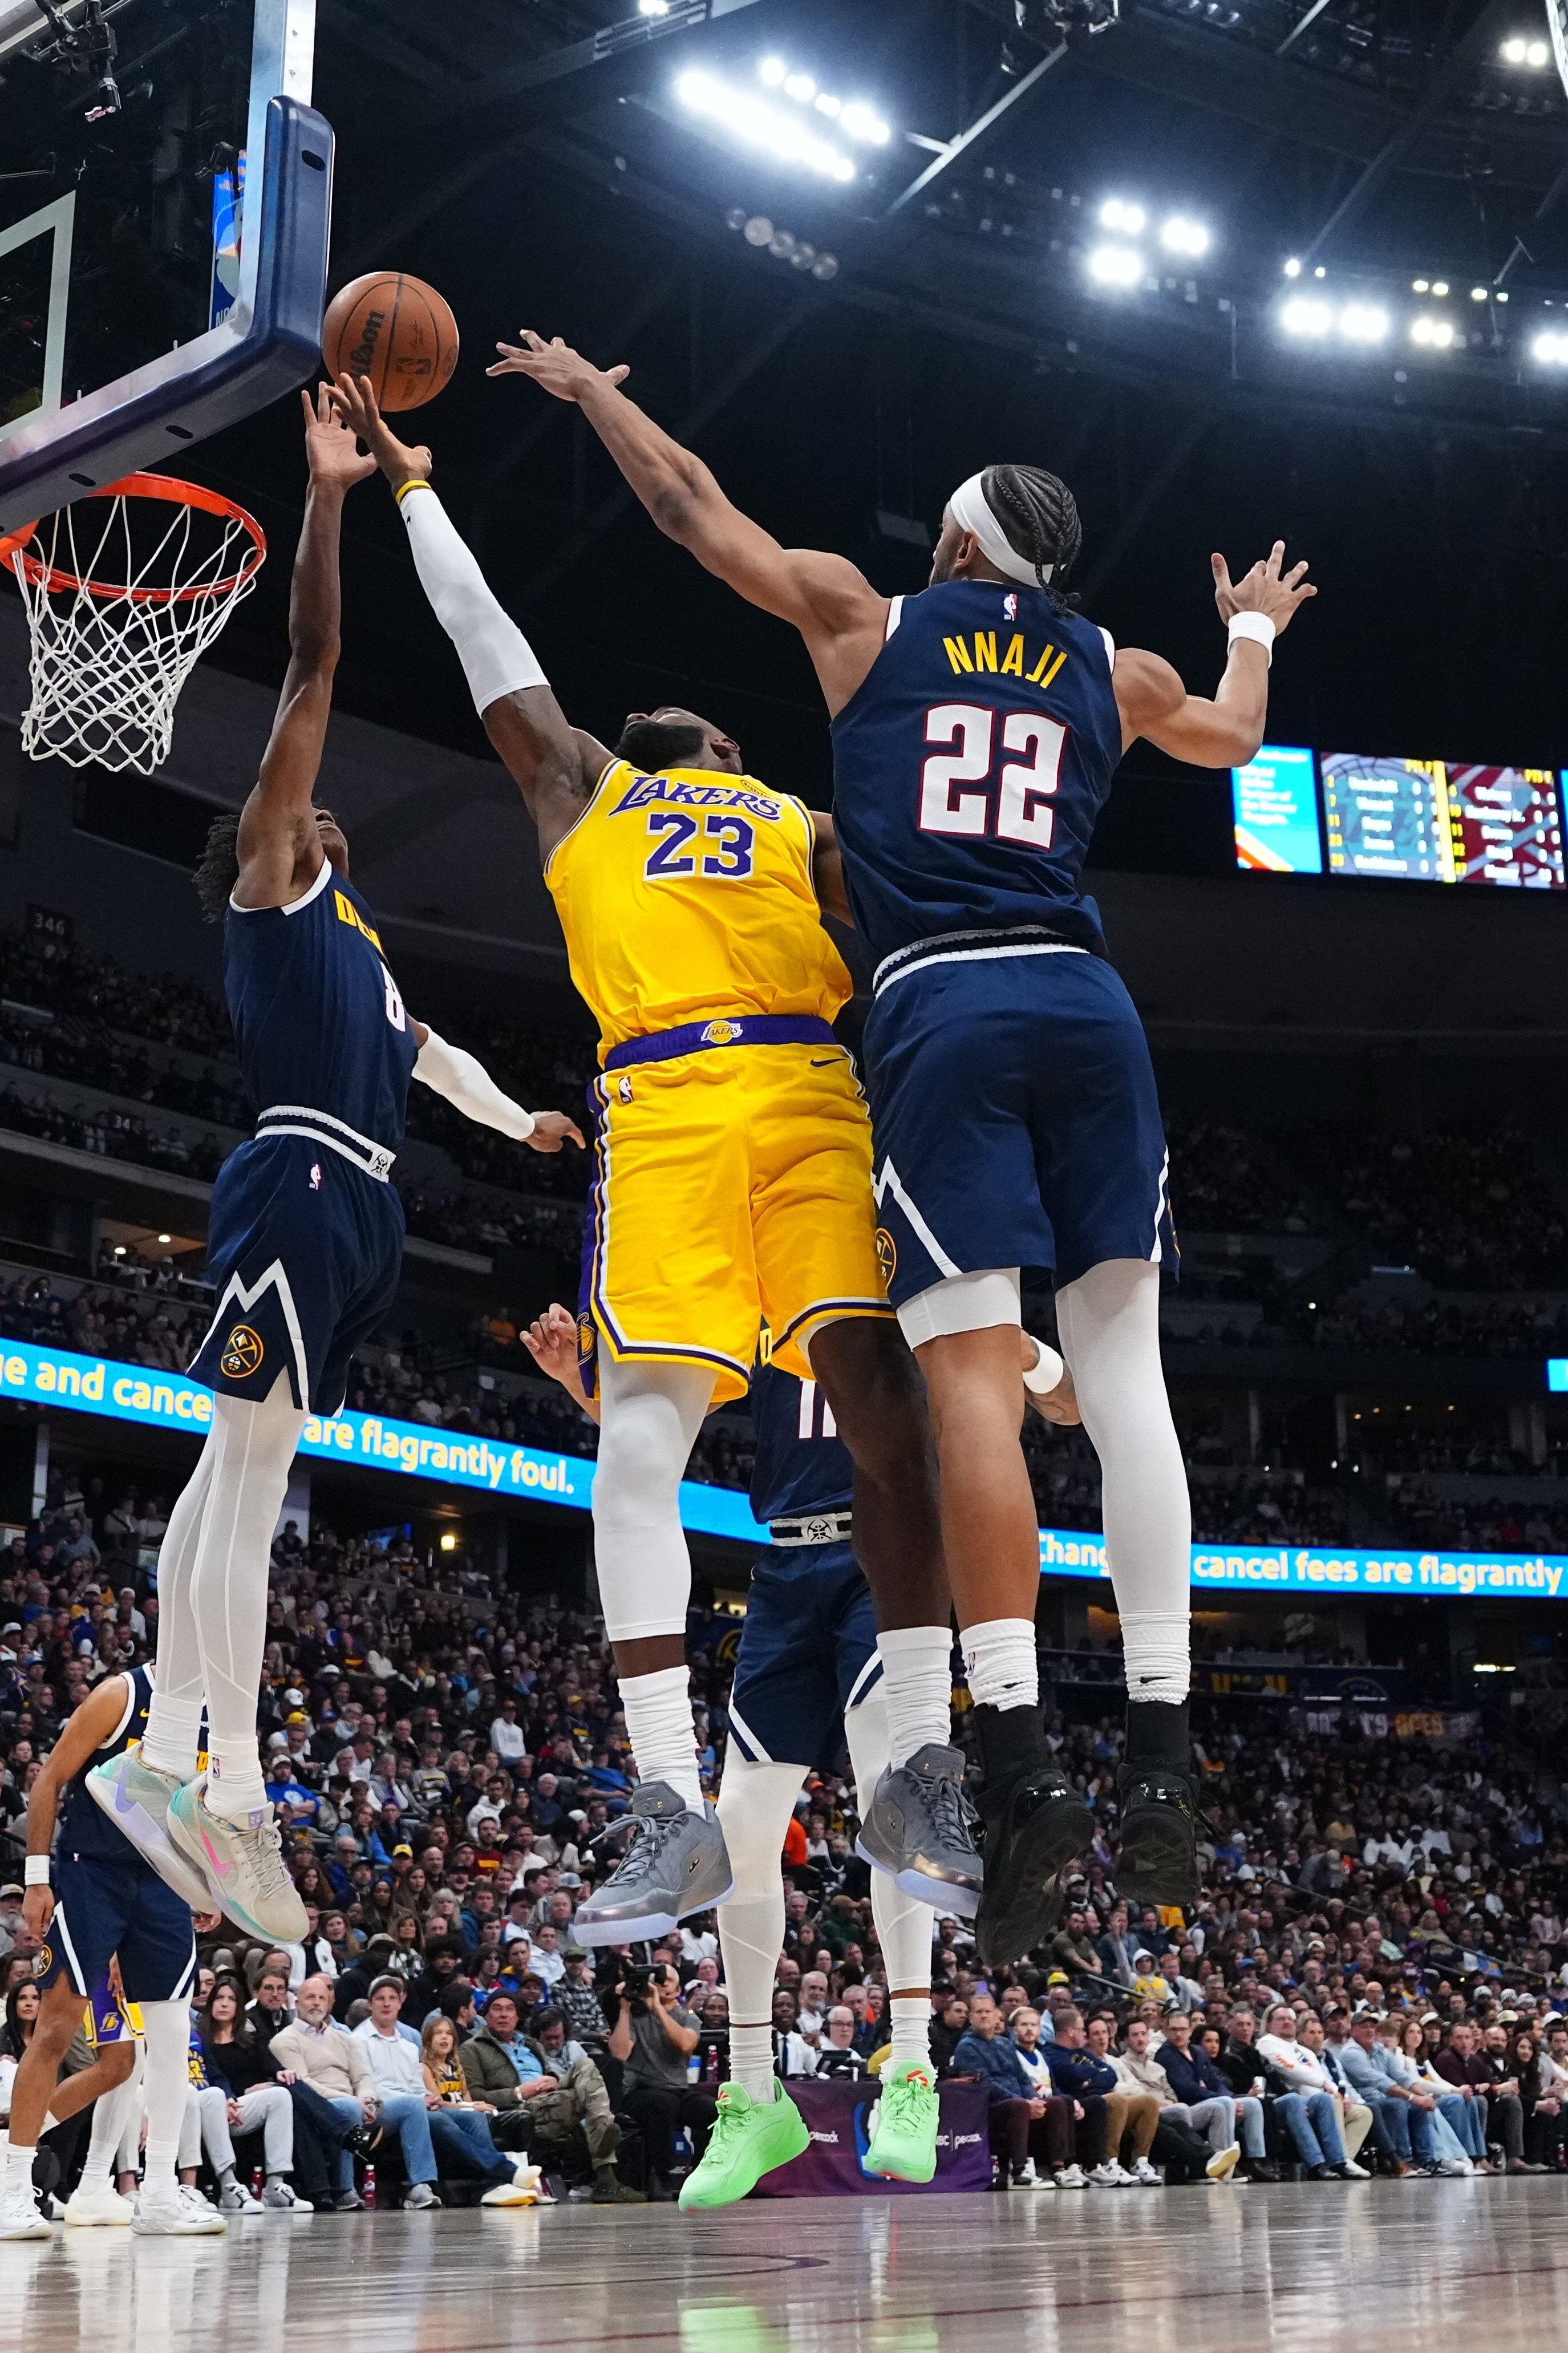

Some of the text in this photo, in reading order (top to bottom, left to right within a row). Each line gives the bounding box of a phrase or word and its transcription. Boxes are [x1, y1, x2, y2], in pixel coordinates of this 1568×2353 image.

[942, 631, 1068, 689] NNAJI
[606, 776, 784, 821] LAKERS
[918, 700, 1070, 852] 22
[643, 811, 756, 882] 23
[702, 1026, 742, 1040] LAKERS
[35, 1363, 106, 1401] and
[113, 1378, 213, 1422] cance
[303, 1416, 574, 1495] are flagrantly foul.
[1194, 1550, 1563, 1595] cancel fees are flagrantly
